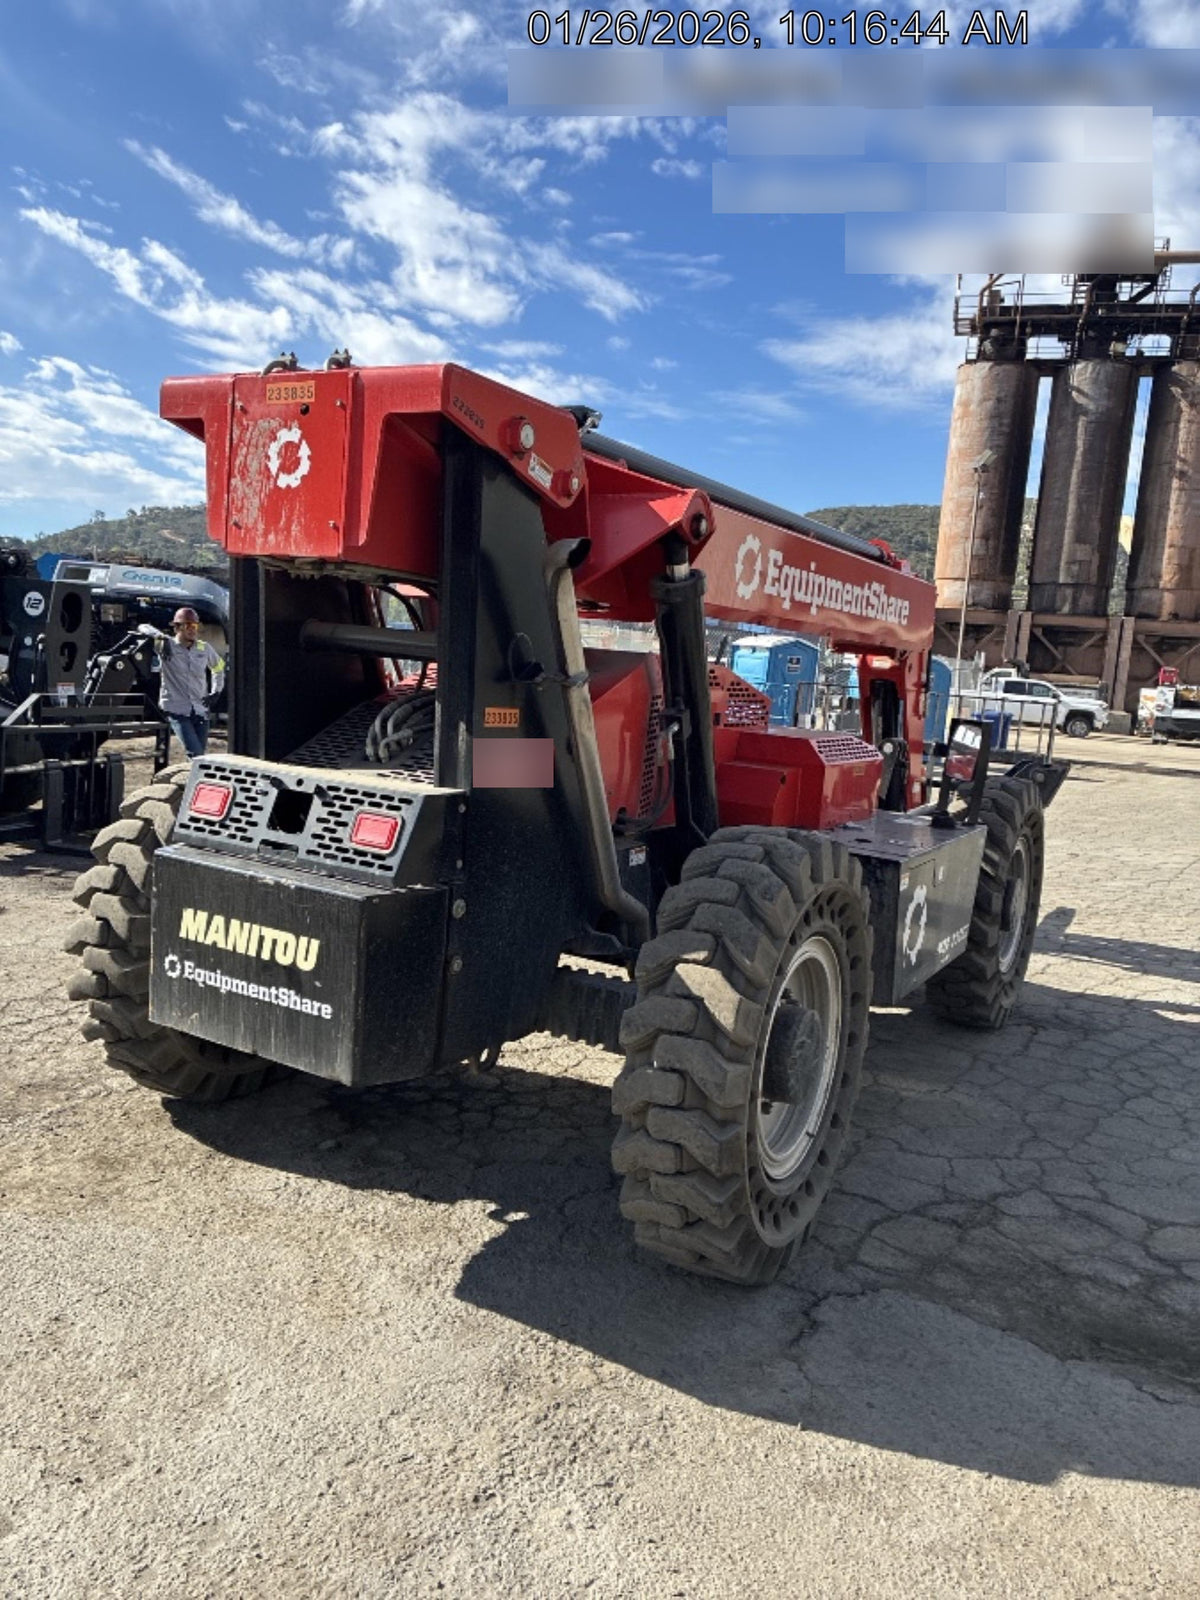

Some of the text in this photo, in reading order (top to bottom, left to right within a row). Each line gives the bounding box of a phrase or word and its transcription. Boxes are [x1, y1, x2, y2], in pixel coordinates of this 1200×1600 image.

[267, 385, 313, 401] 233835
[26, 596, 43, 610] 12
[764, 549, 910, 625] EquipmentShare
[179, 907, 321, 972] MANITOU
[182, 960, 334, 1020] EquipmentShare
